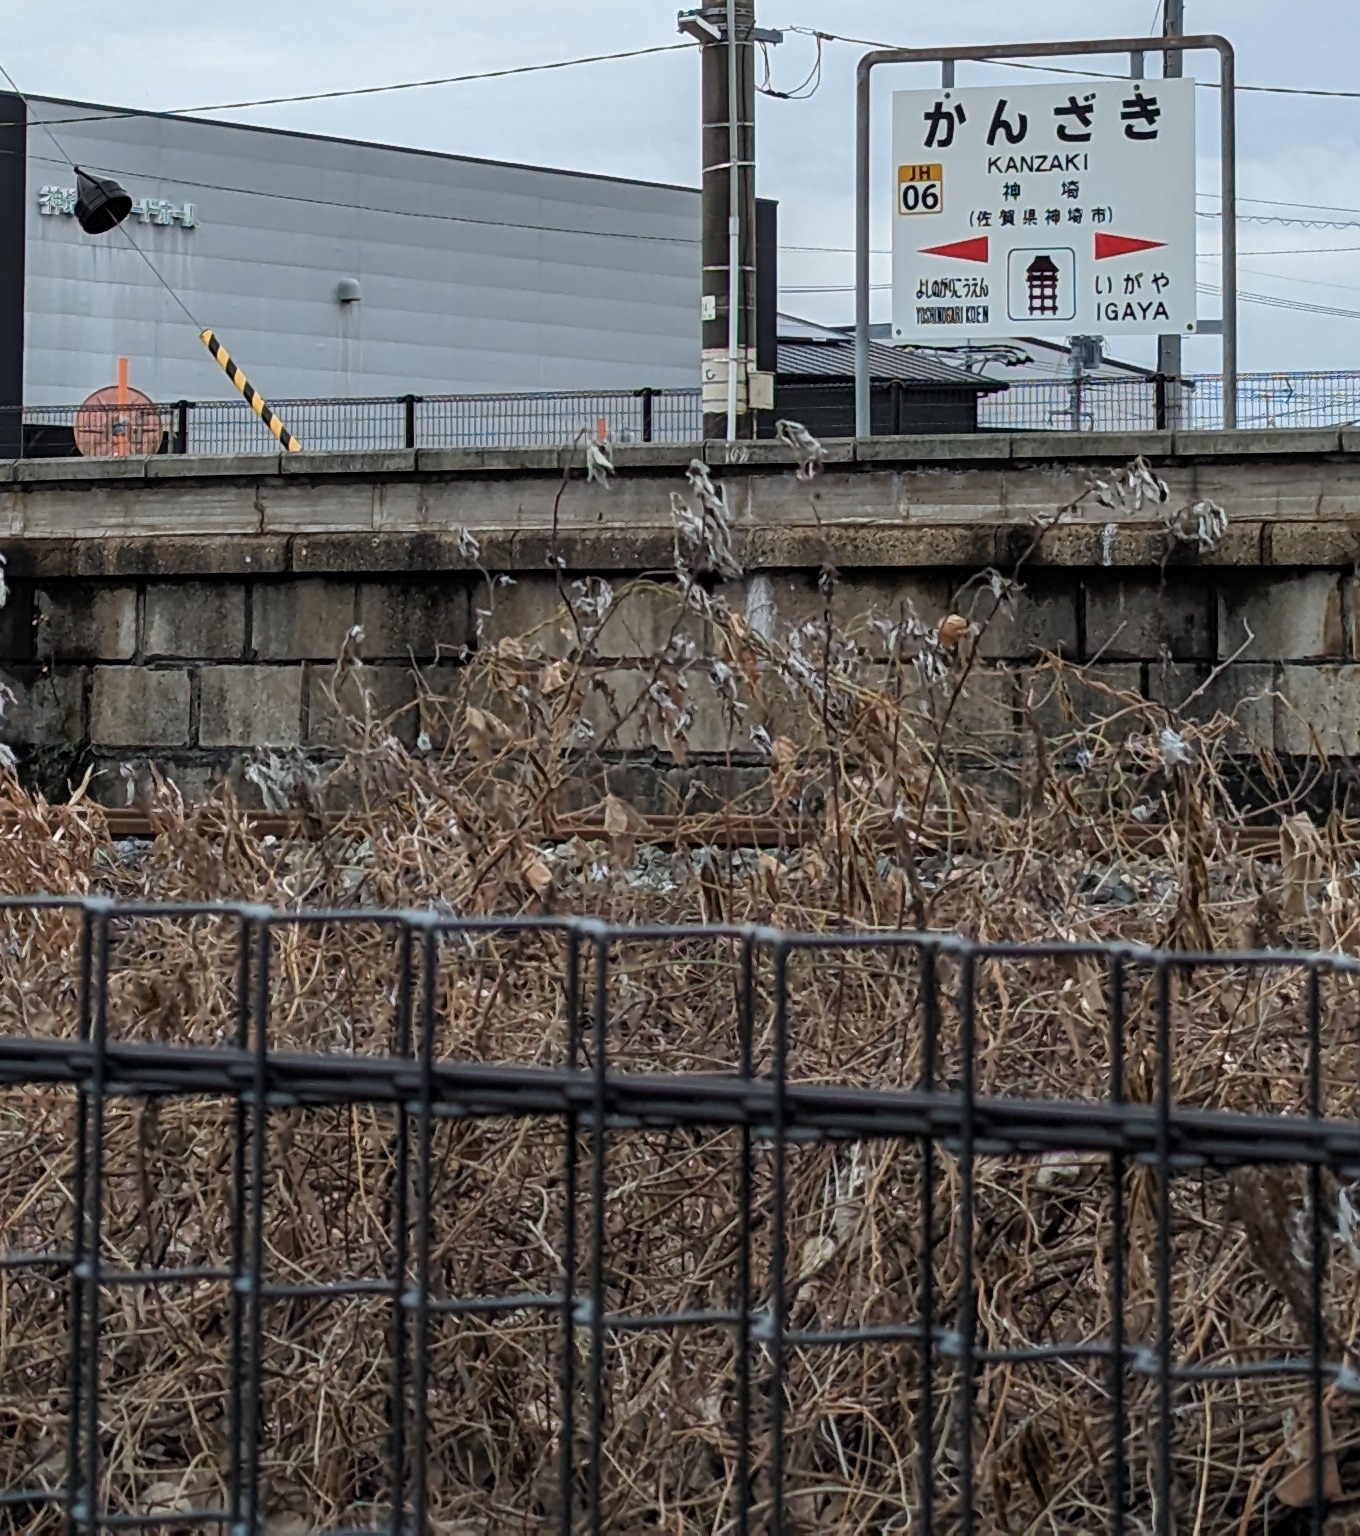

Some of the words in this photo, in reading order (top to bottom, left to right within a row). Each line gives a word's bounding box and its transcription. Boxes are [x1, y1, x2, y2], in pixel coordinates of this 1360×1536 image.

[923, 92, 1161, 149] かんざき
[909, 165, 930, 181] JH
[987, 153, 1088, 174] KANZAKI
[903, 184, 938, 211] 06
[1002, 179, 1080, 201] 神埼
[916, 277, 989, 299] よしのがりこうえん
[1095, 272, 1170, 295] いがや
[1097, 301, 1170, 321] IGAYA
